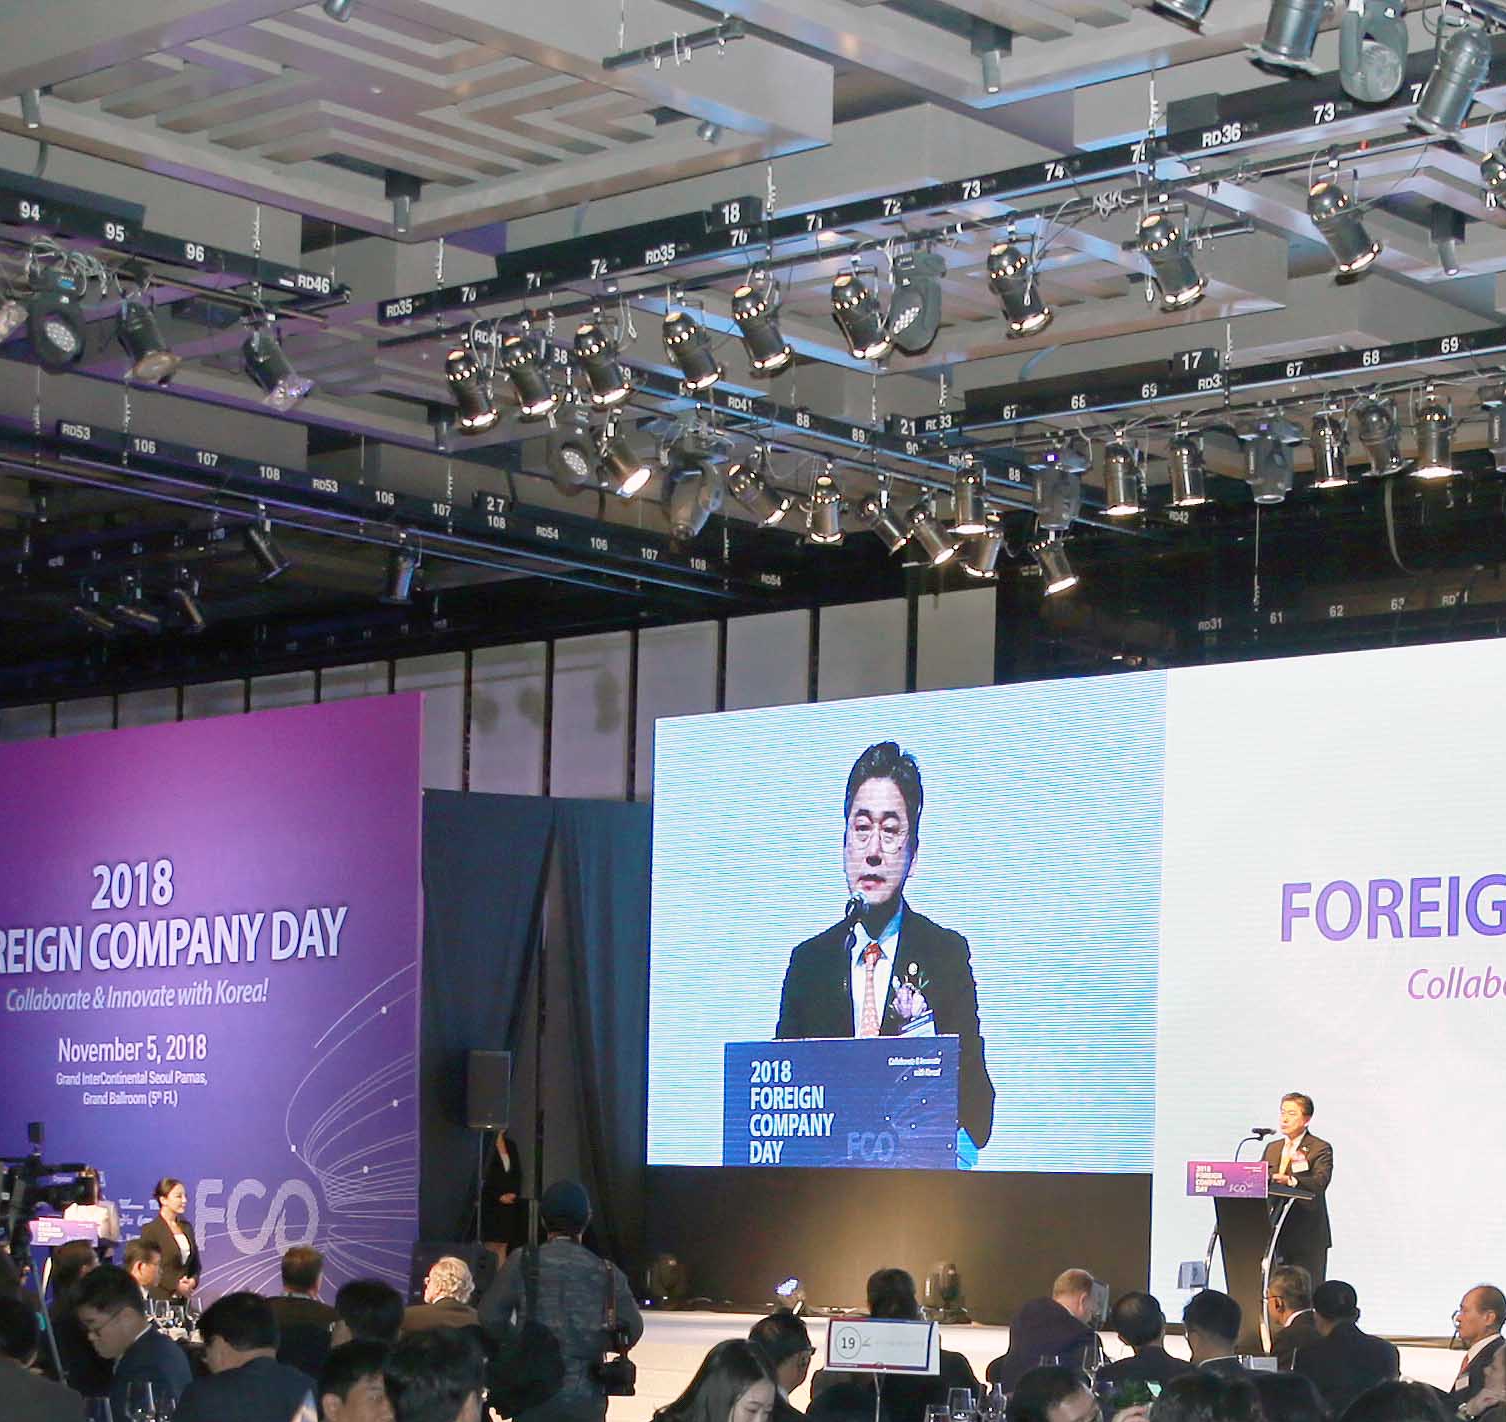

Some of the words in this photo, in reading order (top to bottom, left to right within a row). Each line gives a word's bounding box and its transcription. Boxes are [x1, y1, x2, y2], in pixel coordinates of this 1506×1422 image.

[1313, 103, 1336, 125] 73
[1201, 121, 1242, 148] RD36
[1044, 163, 1066, 182] 74
[961, 180, 982, 200] 73
[20, 201, 41, 222] 94
[722, 203, 741, 225] 18
[105, 222, 125, 243] 95
[186, 243, 205, 262] 96
[645, 243, 677, 265] RD35
[297, 274, 331, 293] RD46
[386, 298, 413, 318] RD35
[1441, 336, 1459, 354] 69
[1181, 352, 1202, 370] 17
[1362, 349, 1381, 366] 68
[1286, 361, 1304, 378] 67
[796, 413, 811, 429] 88
[1003, 404, 1019, 420] 67
[61, 423, 91, 441] RD53
[900, 419, 916, 436] 21
[133, 439, 156, 454] 106
[196, 451, 218, 467] 107
[259, 465, 280, 481] 108
[312, 478, 339, 494] RD53
[374, 490, 395, 506] 106
[432, 502, 452, 518] 107
[535, 525, 559, 541] RD54
[90, 858, 174, 911] 2018
[88, 912, 264, 971] COMPANY
[269, 905, 349, 960] DAY
[5, 986, 91, 1012] Collaborate
[92, 985, 105, 1008] &
[107, 983, 175, 1009] Innovate
[177, 979, 213, 1007] with
[215, 977, 269, 1004] Korea!
[57, 1036, 144, 1064] November
[145, 1035, 163, 1065] 5,
[165, 1033, 208, 1061] 2018
[750, 1060, 792, 1083] 2018
[750, 1085, 825, 1111] FOREIGN
[749, 1112, 835, 1138] COMPANY
[749, 1140, 784, 1165] DAY
[841, 1336, 855, 1350] 19
